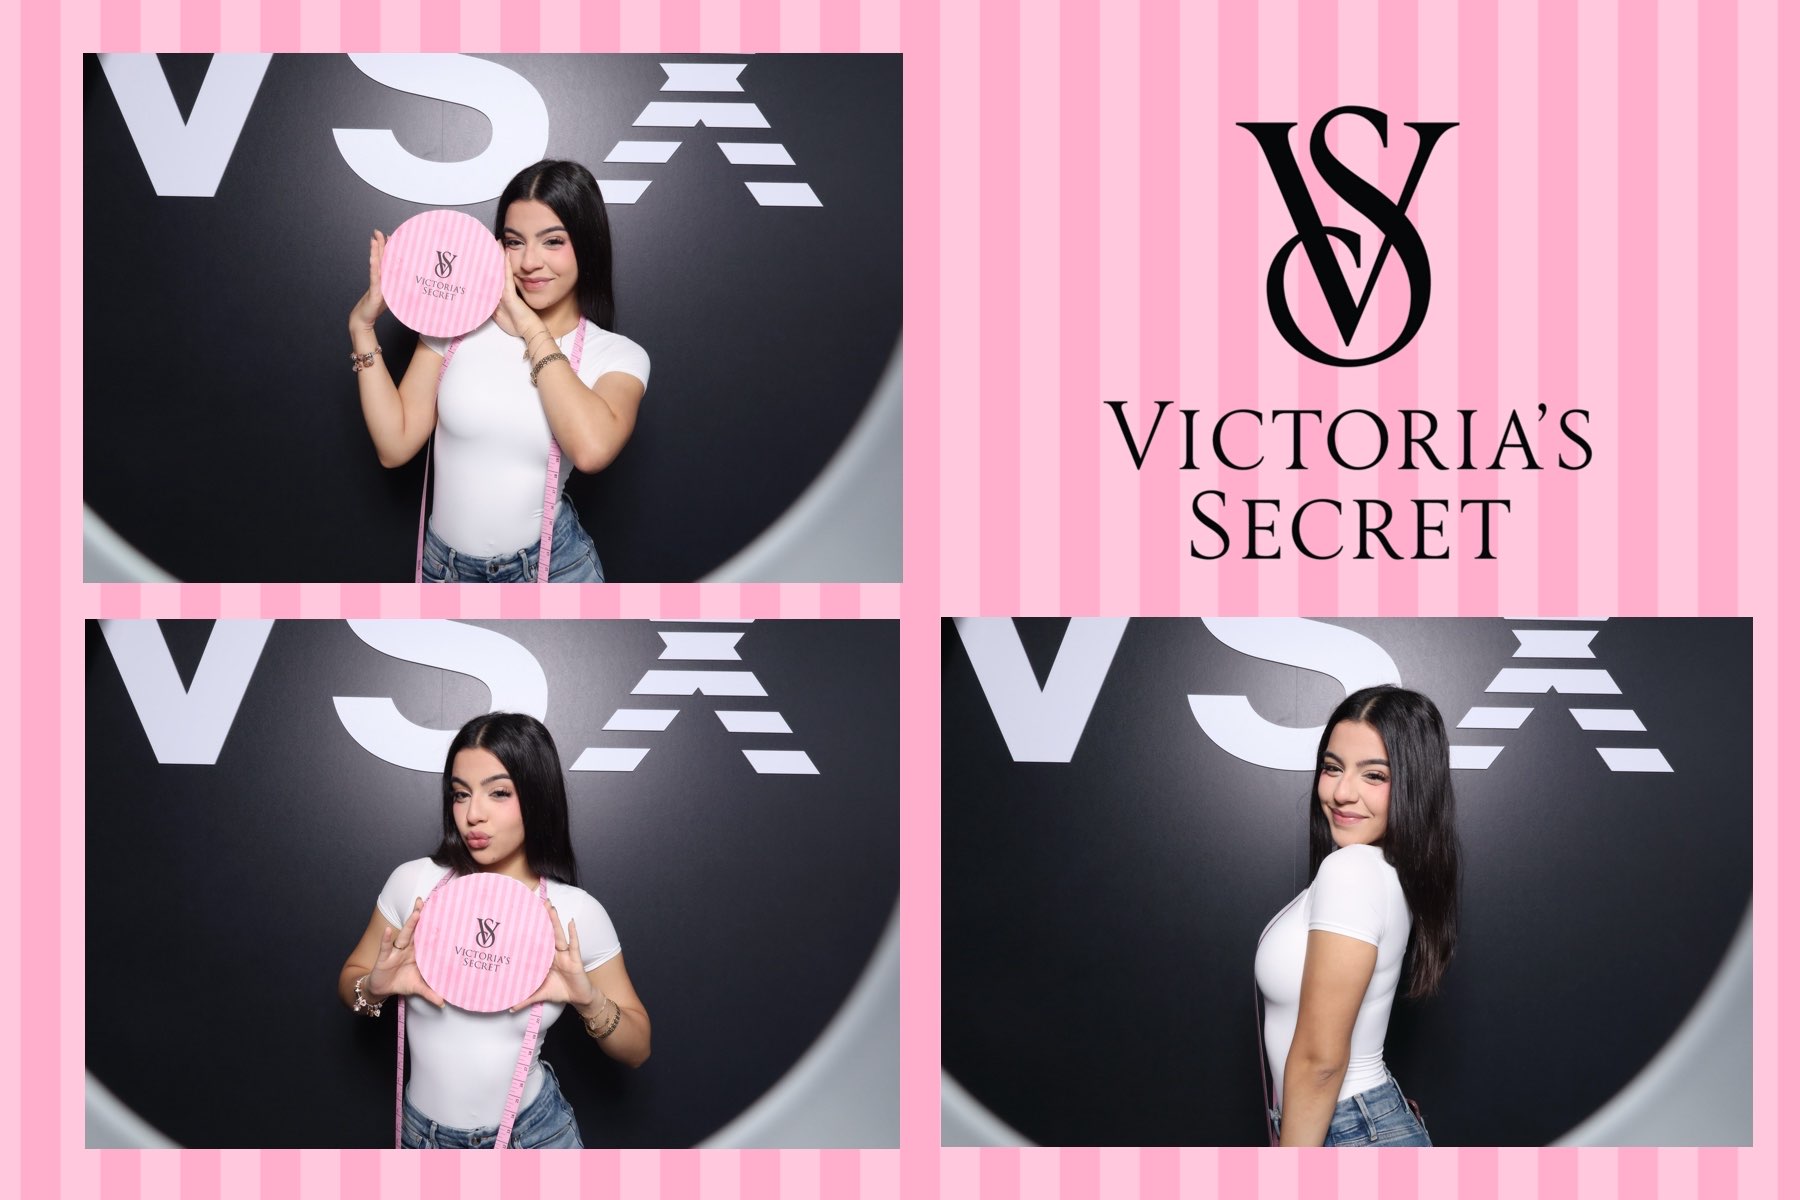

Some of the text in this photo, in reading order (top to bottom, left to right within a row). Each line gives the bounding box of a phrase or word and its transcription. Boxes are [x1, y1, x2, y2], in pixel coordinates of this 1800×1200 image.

[415, 275, 466, 295] VICTORIA'S
[422, 286, 457, 301] SECRET
[455, 945, 511, 965] VICTORIA'S
[463, 957, 501, 973] SECRET
